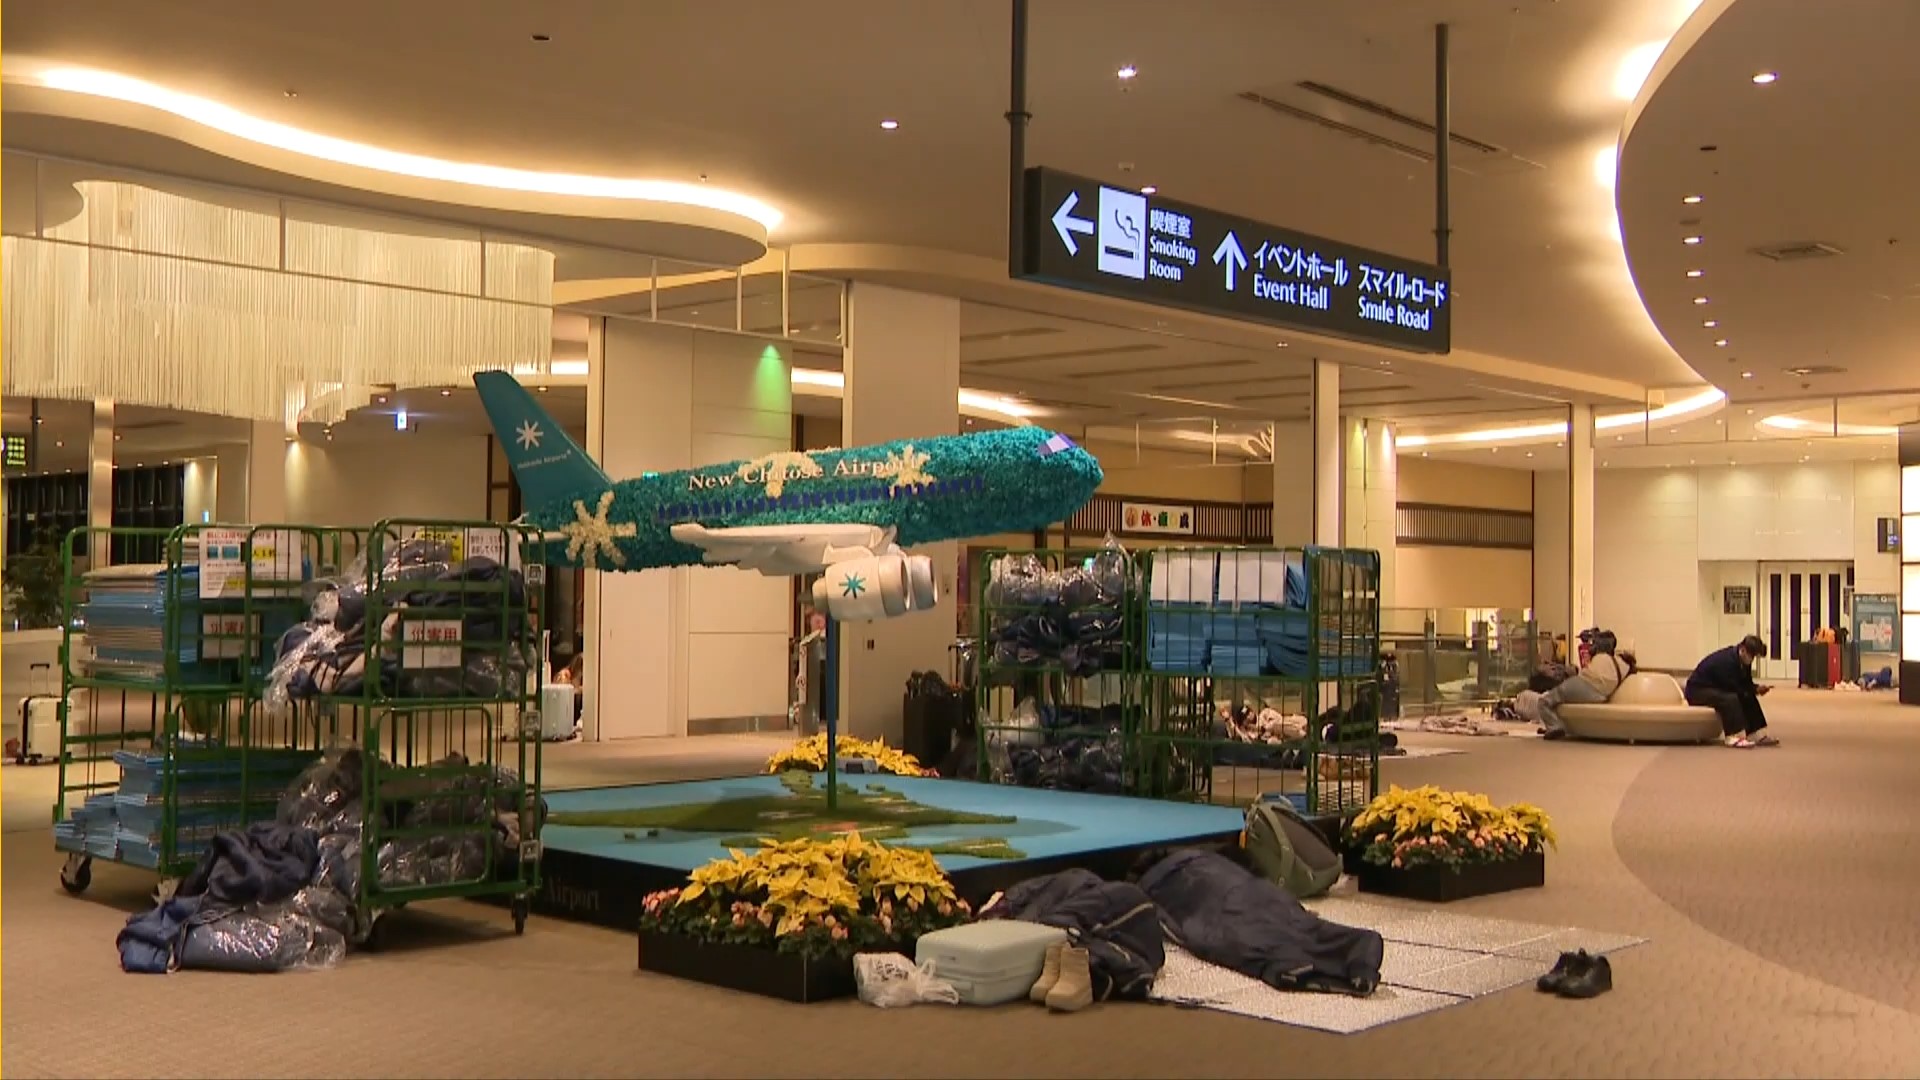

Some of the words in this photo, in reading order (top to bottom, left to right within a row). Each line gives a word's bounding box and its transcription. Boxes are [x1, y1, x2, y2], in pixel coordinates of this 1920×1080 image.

[1150, 209, 1191, 239] 喫煙室
[1150, 235, 1196, 266] Smoking
[1253, 241, 1349, 286] イベントホール
[1150, 258, 1182, 280] Room
[1253, 273, 1297, 304] Event
[1299, 283, 1329, 310] Hall
[1358, 296, 1395, 323] Smile
[1397, 304, 1430, 331] Road
[688, 472, 737, 490] New
[743, 466, 824, 484] Chtose
[833, 453, 920, 477] Airport
